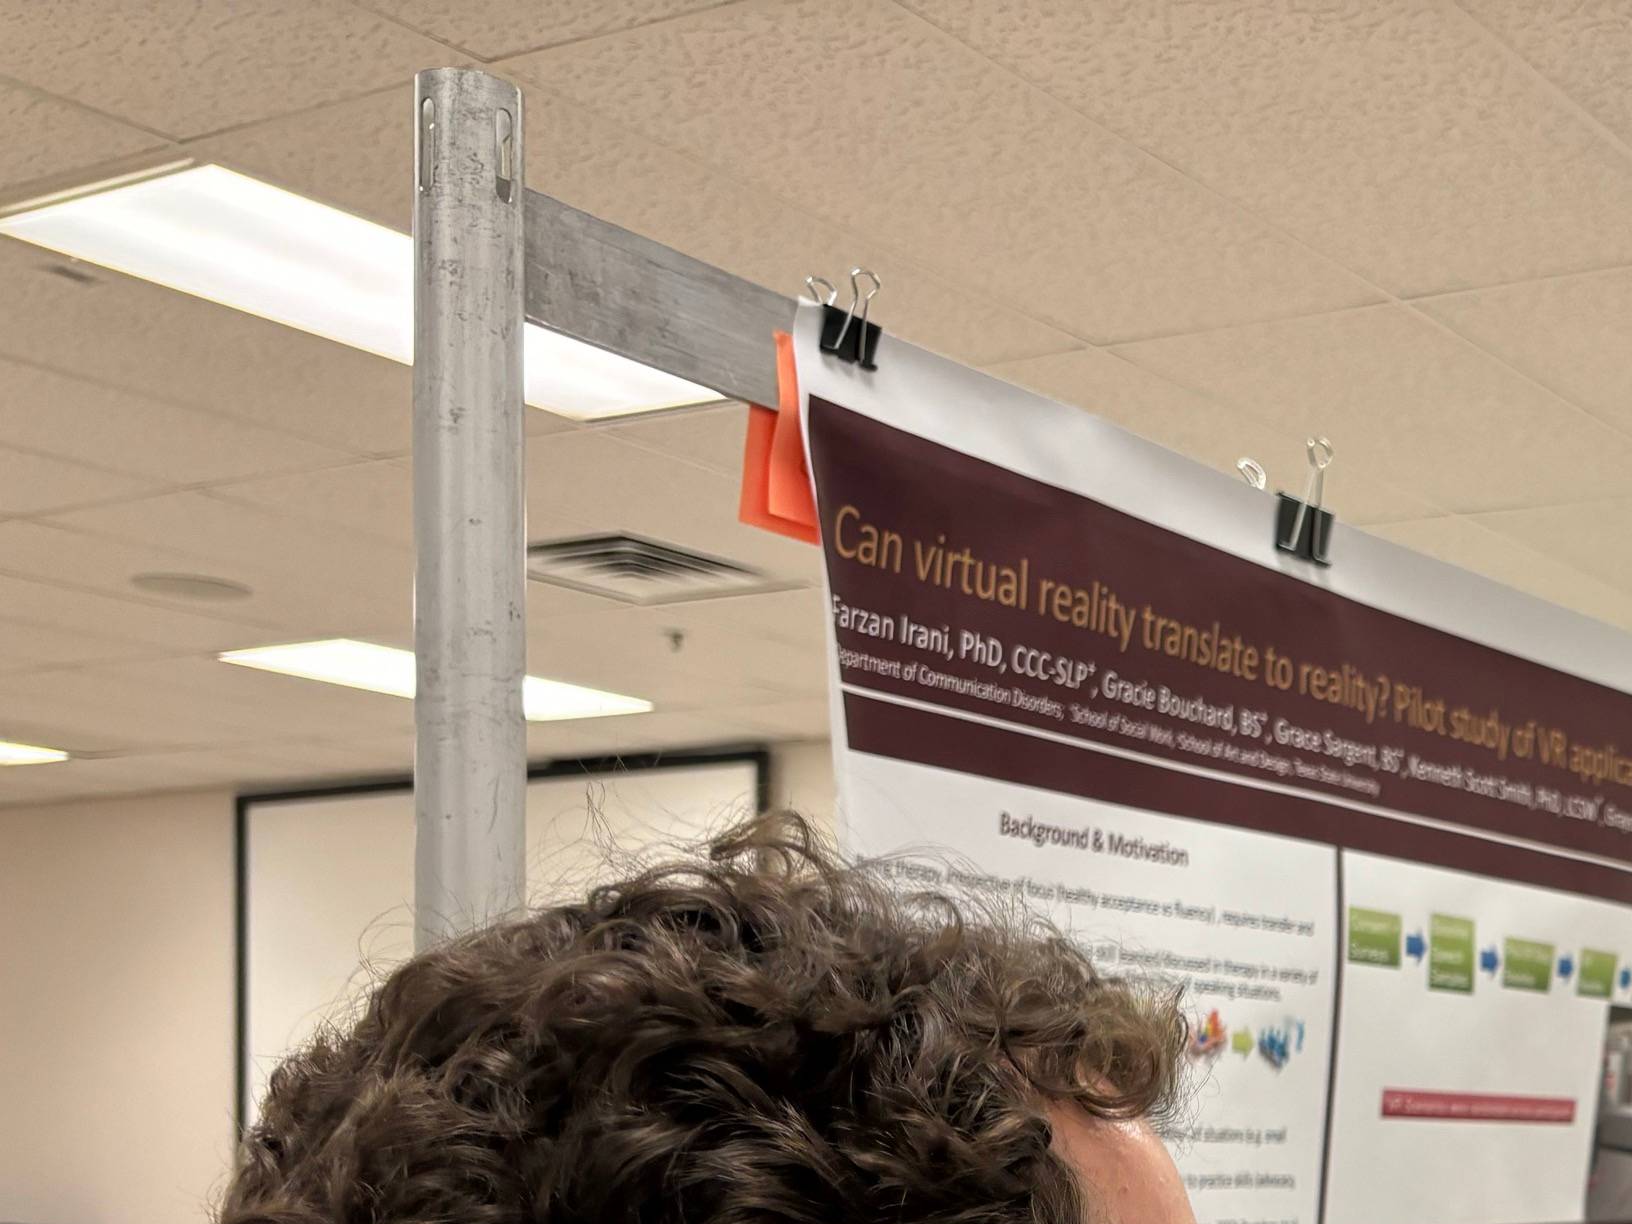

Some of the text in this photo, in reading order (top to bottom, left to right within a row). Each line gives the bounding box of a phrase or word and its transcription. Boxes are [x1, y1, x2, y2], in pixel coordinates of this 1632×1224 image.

[834, 505, 902, 573] Can
[914, 534, 1028, 610] virtual
[1039, 581, 1136, 653] reality
[1142, 605, 1259, 680] translate
[1265, 647, 1293, 690] to
[1299, 663, 1391, 724] reality?
[1393, 683, 1446, 736] Pilot
[1450, 708, 1510, 761] study
[1511, 719, 1537, 759] of
[1537, 726, 1567, 769] VR
[902, 660, 918, 683] of
[917, 663, 1011, 707] Communication
[900, 613, 954, 662] Irani,
[959, 629, 1007, 674] PhD,
[1102, 670, 1156, 710] Gracie
[1157, 685, 1238, 737] Bouchard,
[1274, 717, 1322, 753] Grace
[1323, 729, 1380, 771] Sargent,
[1407, 754, 1464, 789] Kenneth
[999, 811, 1190, 868] Background & Motivation
